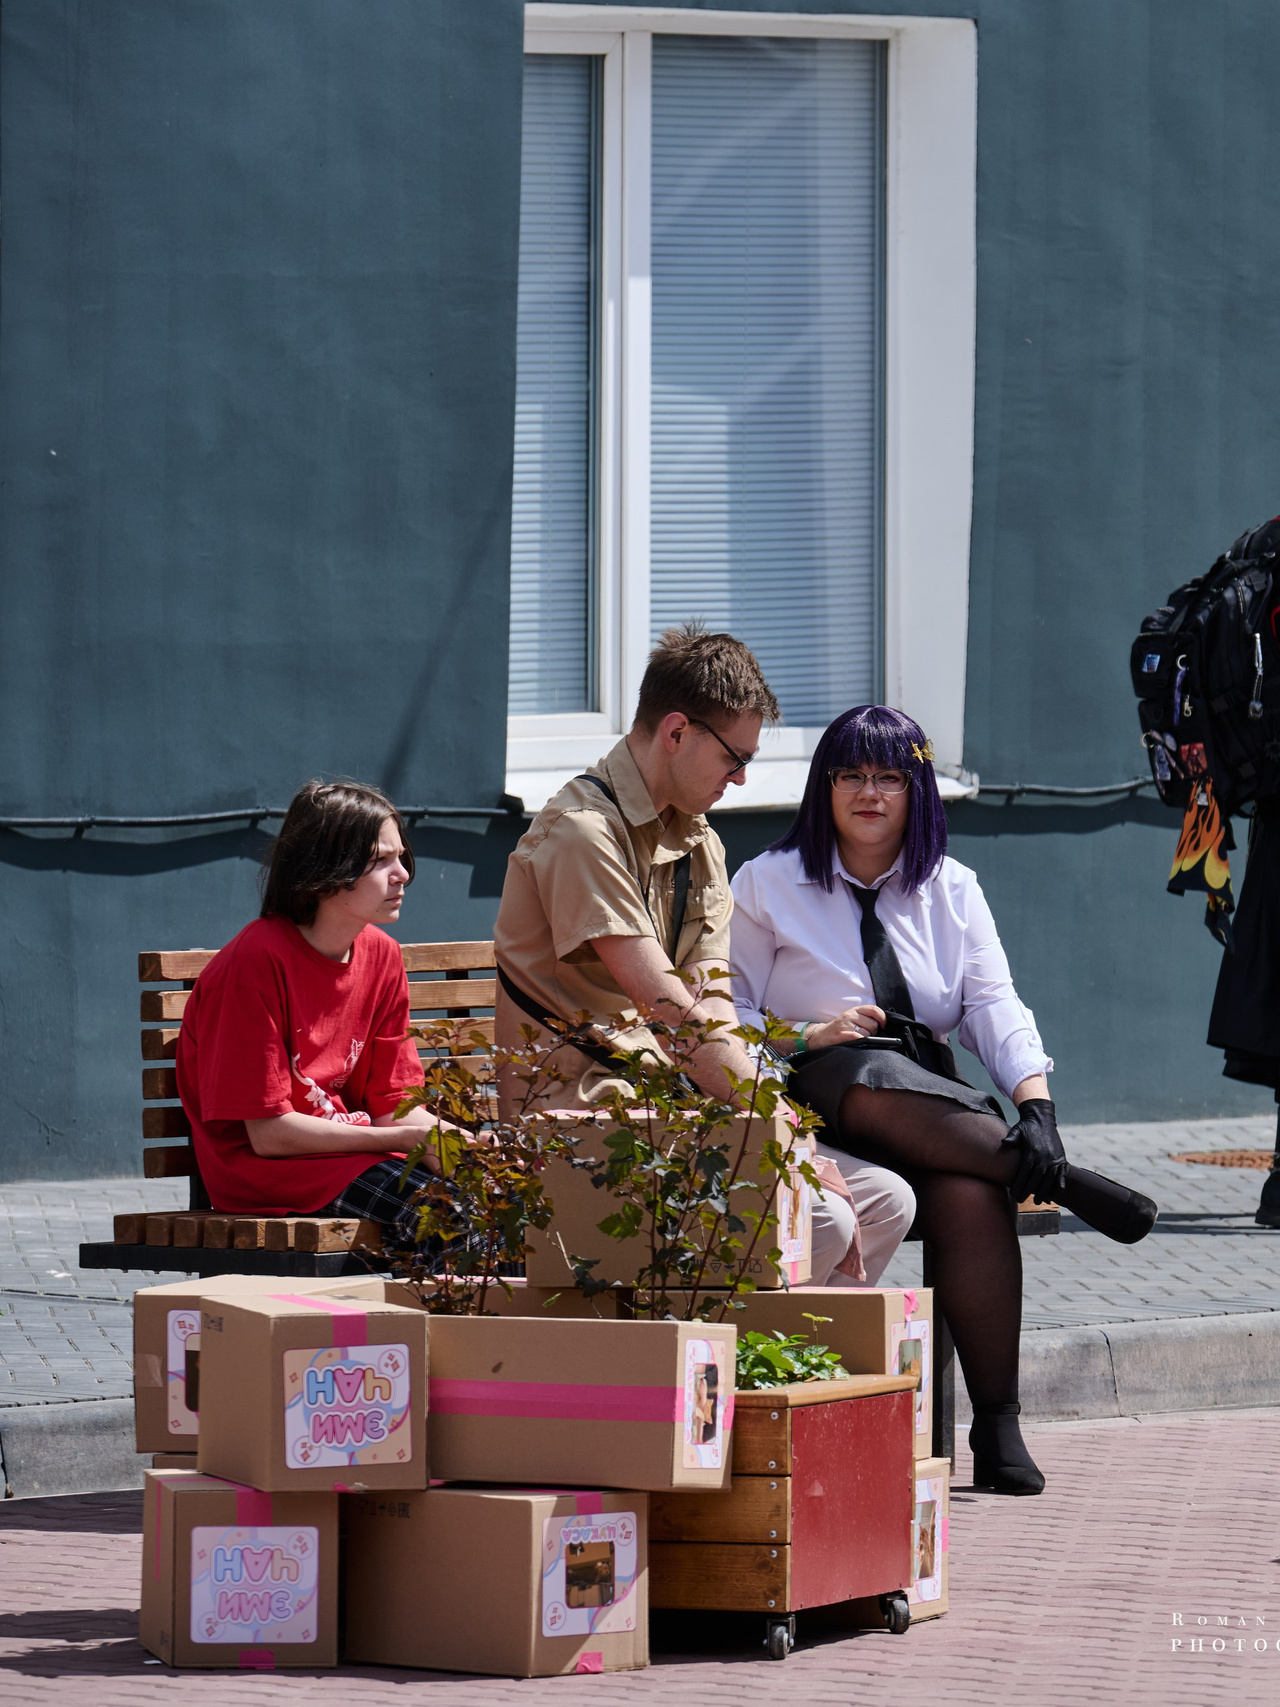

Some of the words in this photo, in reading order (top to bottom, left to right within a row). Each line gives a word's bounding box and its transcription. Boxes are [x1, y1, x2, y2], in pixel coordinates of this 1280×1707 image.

[306, 1367, 392, 1405] ЧАН
[312, 1410, 385, 1444] ЭМИ
[562, 1525, 617, 1541] ЦУКАСА
[214, 1547, 299, 1582] ЧАН
[217, 1590, 291, 1622] ЭМИ
